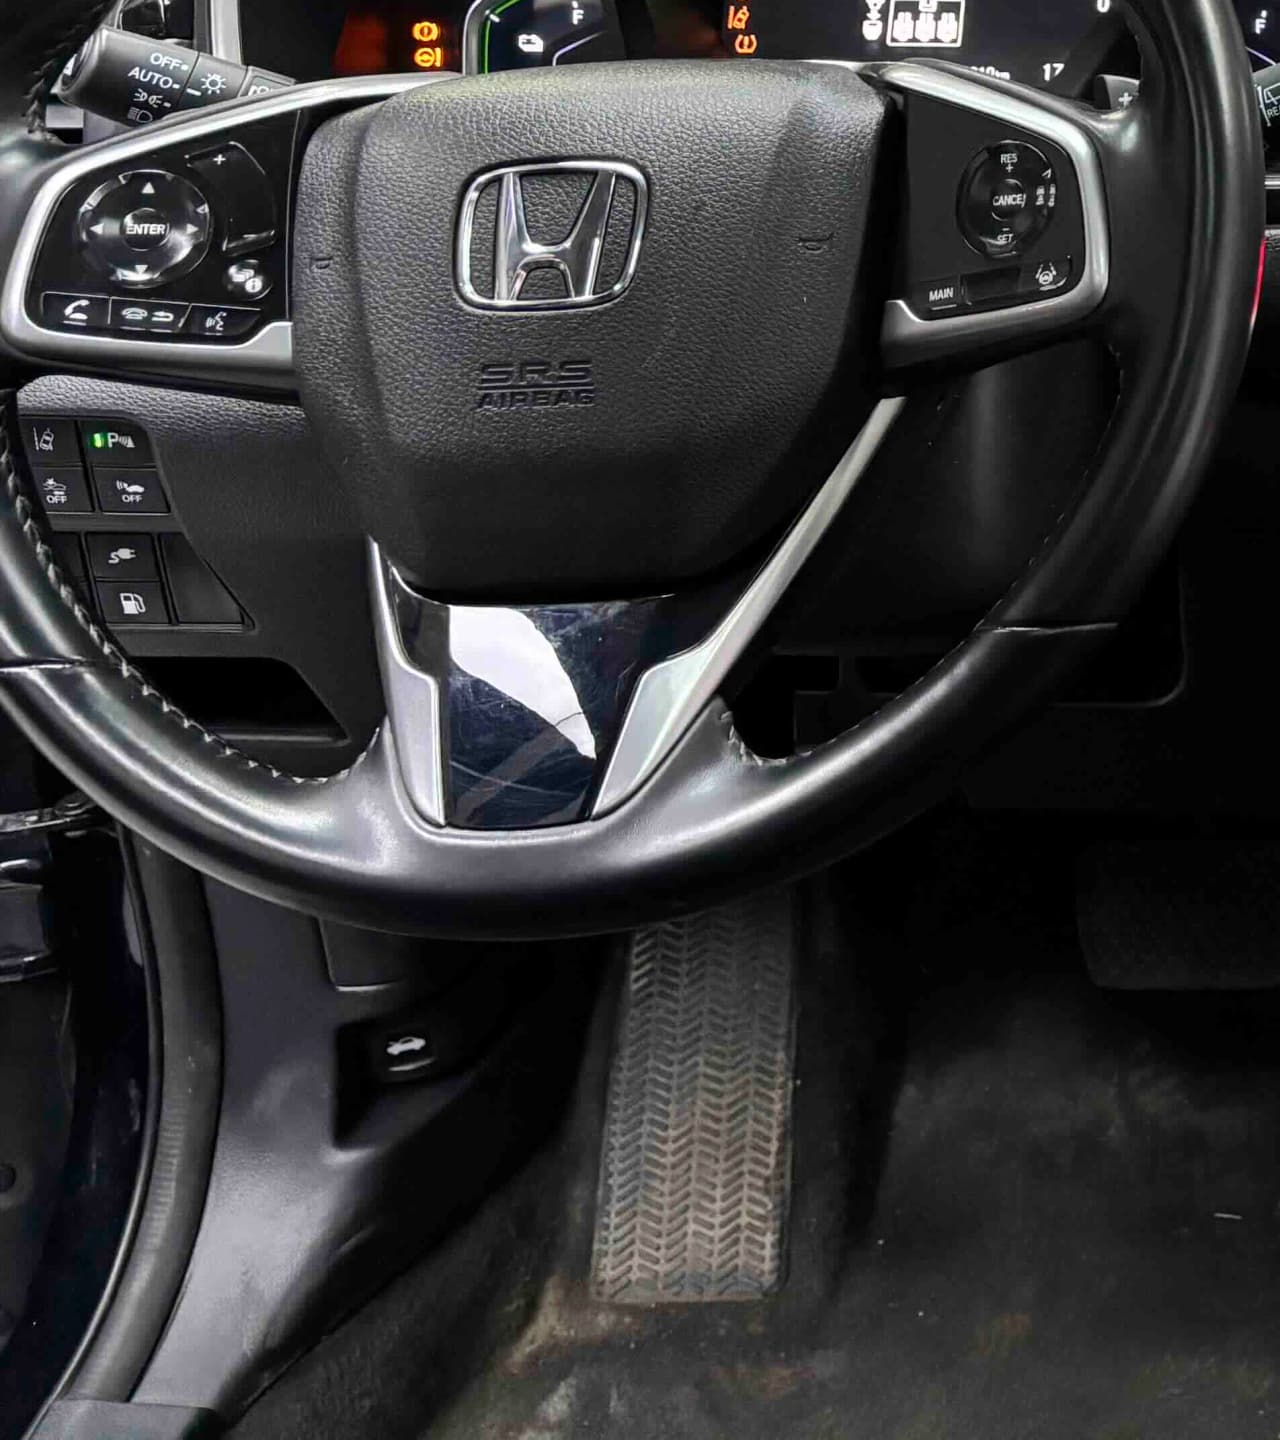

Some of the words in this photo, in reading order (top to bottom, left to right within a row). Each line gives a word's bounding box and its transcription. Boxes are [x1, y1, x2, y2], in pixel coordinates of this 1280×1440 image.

[572, 9, 584, 25] F
[1255, 18, 1267, 35] F
[150, 52, 182, 71] OFF
[128, 66, 173, 88] AUTO
[1000, 153, 1018, 164] RES
[126, 223, 165, 235] ENTER
[928, 287, 954, 302] MAIN
[481, 360, 593, 386] SRS
[477, 389, 596, 411] AIRBAG
[46, 495, 67, 504] OFF
[121, 495, 142, 503] OFF
